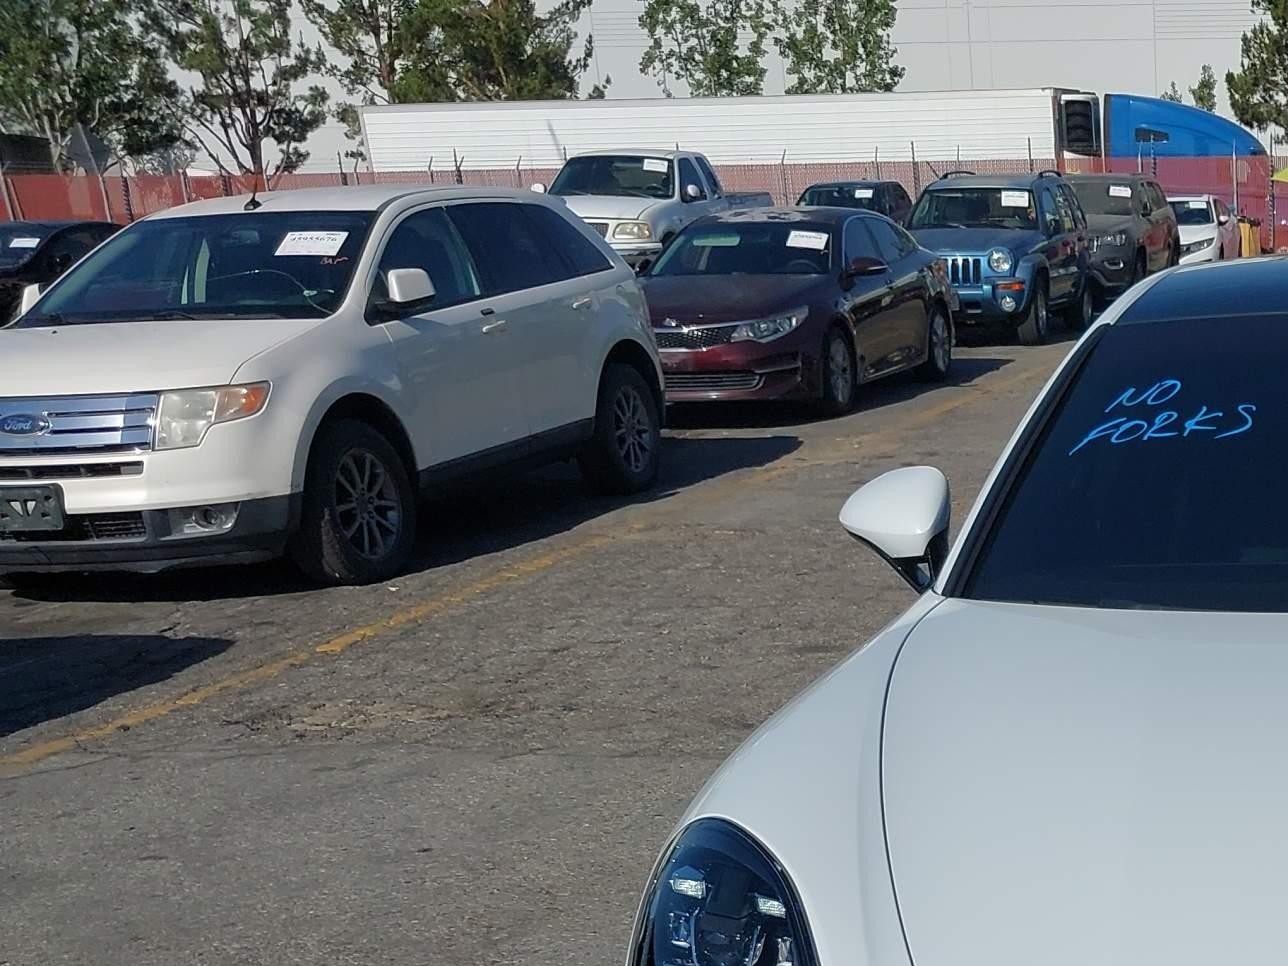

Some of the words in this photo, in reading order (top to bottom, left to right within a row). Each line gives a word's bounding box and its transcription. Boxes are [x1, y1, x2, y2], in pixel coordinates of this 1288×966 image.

[1104, 379, 1181, 413] NO
[4, 419, 32, 431] Ford
[1068, 404, 1256, 456] FORKS
